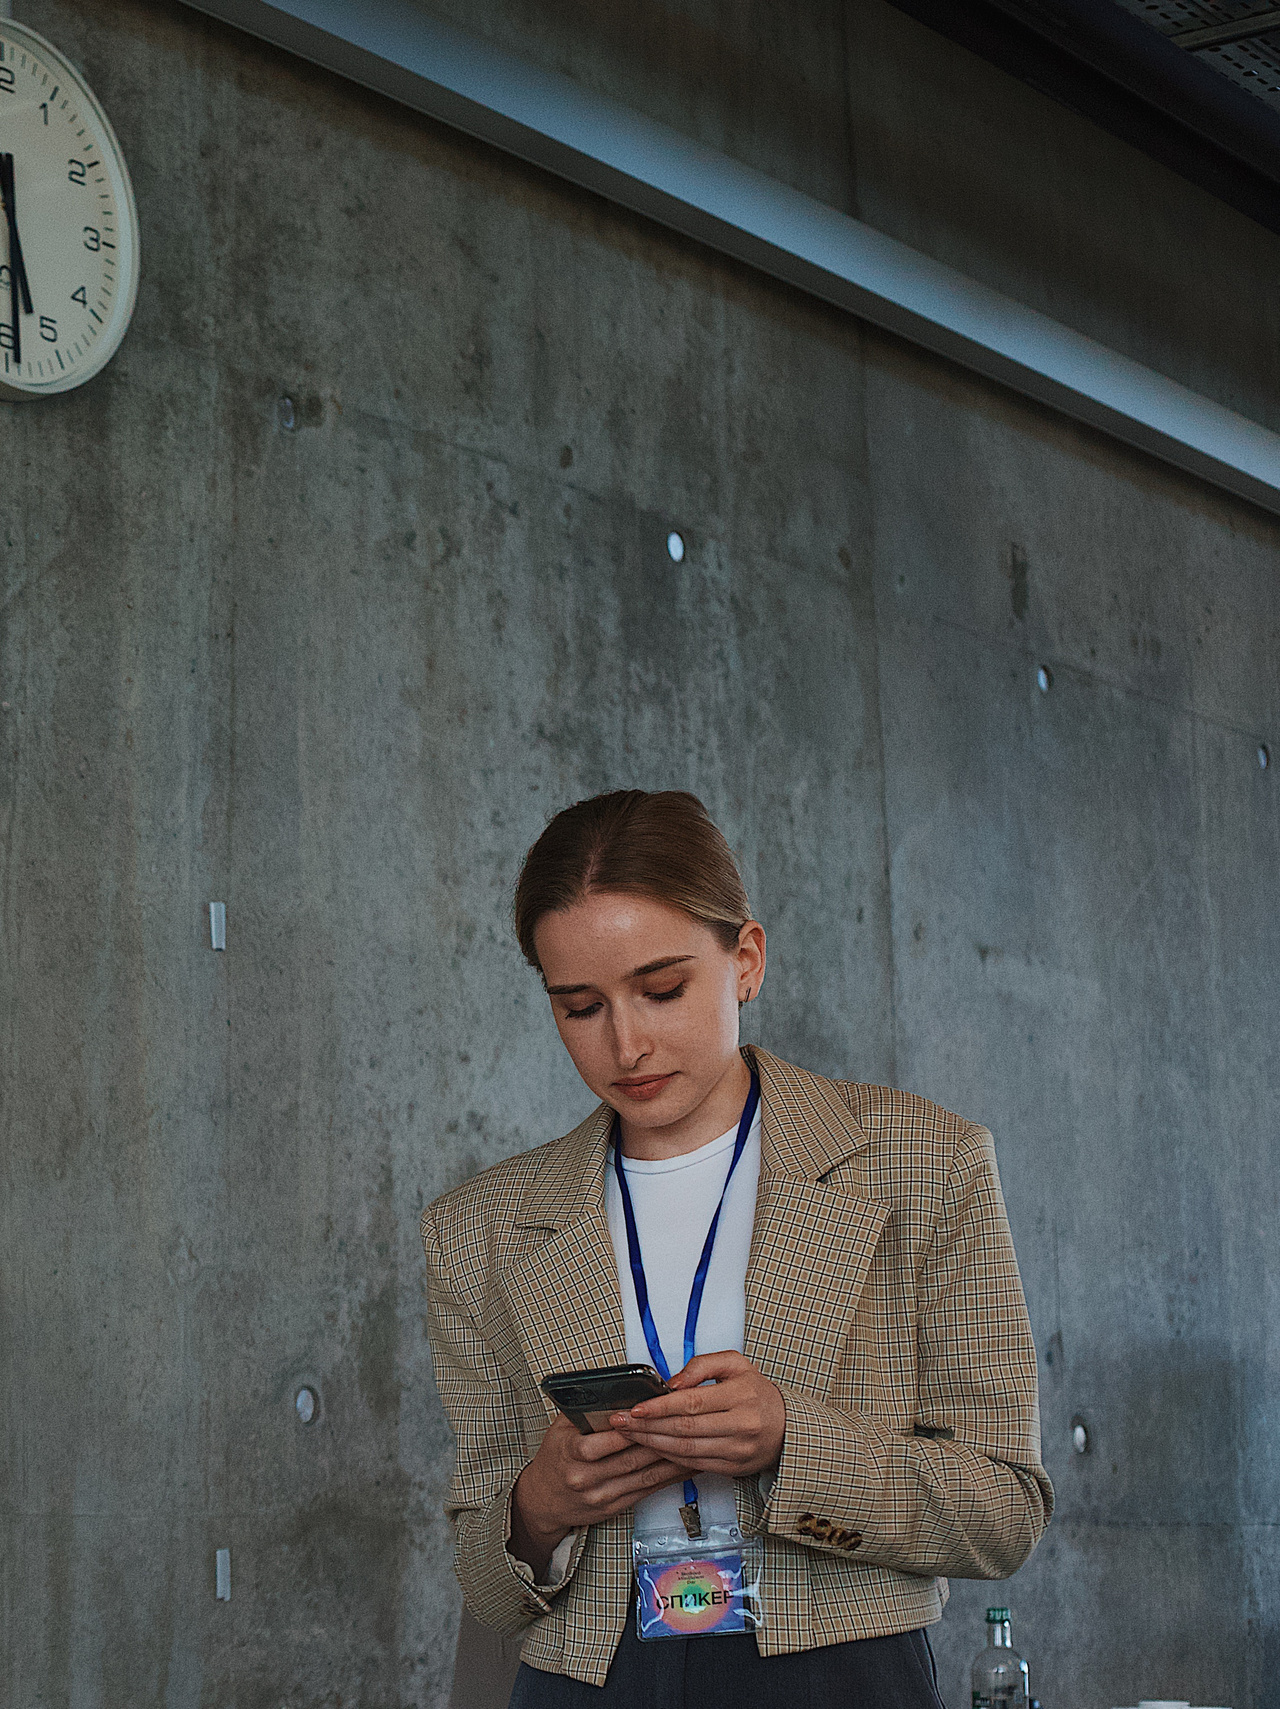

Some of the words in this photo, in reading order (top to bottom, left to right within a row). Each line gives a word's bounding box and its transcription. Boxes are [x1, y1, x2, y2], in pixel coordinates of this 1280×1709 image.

[39, 102, 49, 126] 1
[68, 158, 87, 186] 2
[83, 226, 101, 252] 3
[70, 286, 88, 309] 4
[39, 315, 58, 343] 5
